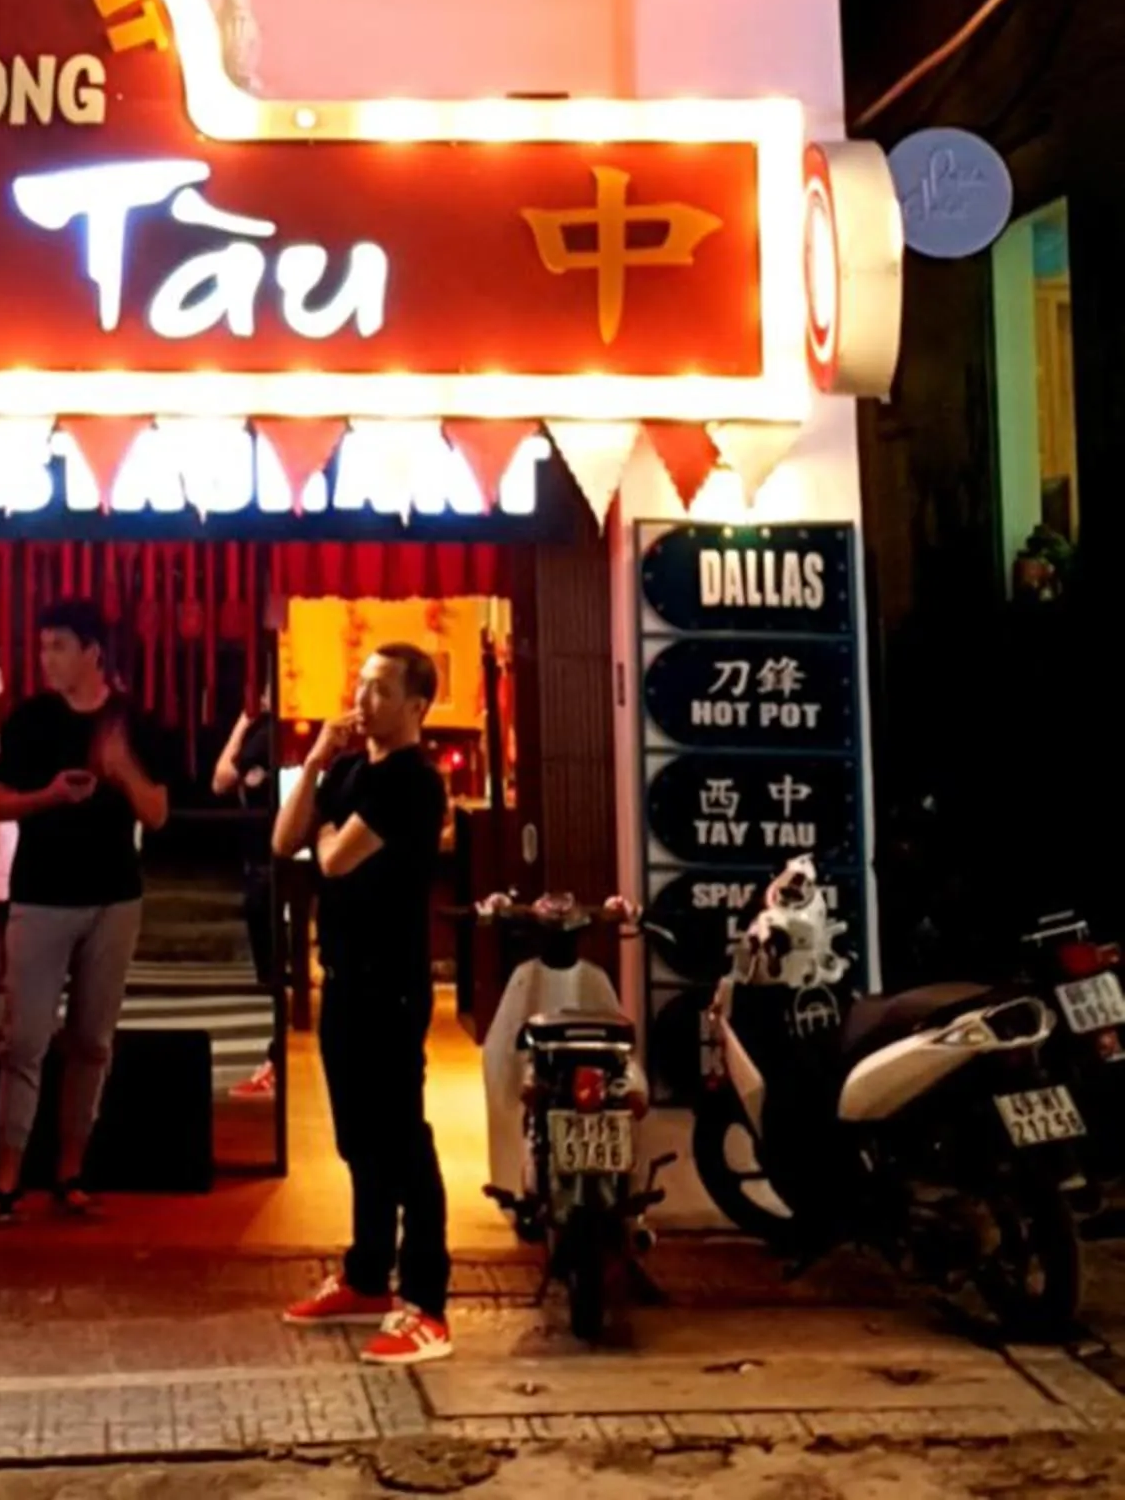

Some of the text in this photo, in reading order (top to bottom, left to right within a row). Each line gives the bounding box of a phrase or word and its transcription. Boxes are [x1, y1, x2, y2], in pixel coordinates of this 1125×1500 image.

[12, 158, 390, 340] Tàu
[521, 164, 723, 345] 中
[699, 549, 825, 610] DALLAS
[690, 700, 820, 730] HOT POT
[699, 774, 813, 819] 西 中
[693, 819, 817, 849] TAY TAU
